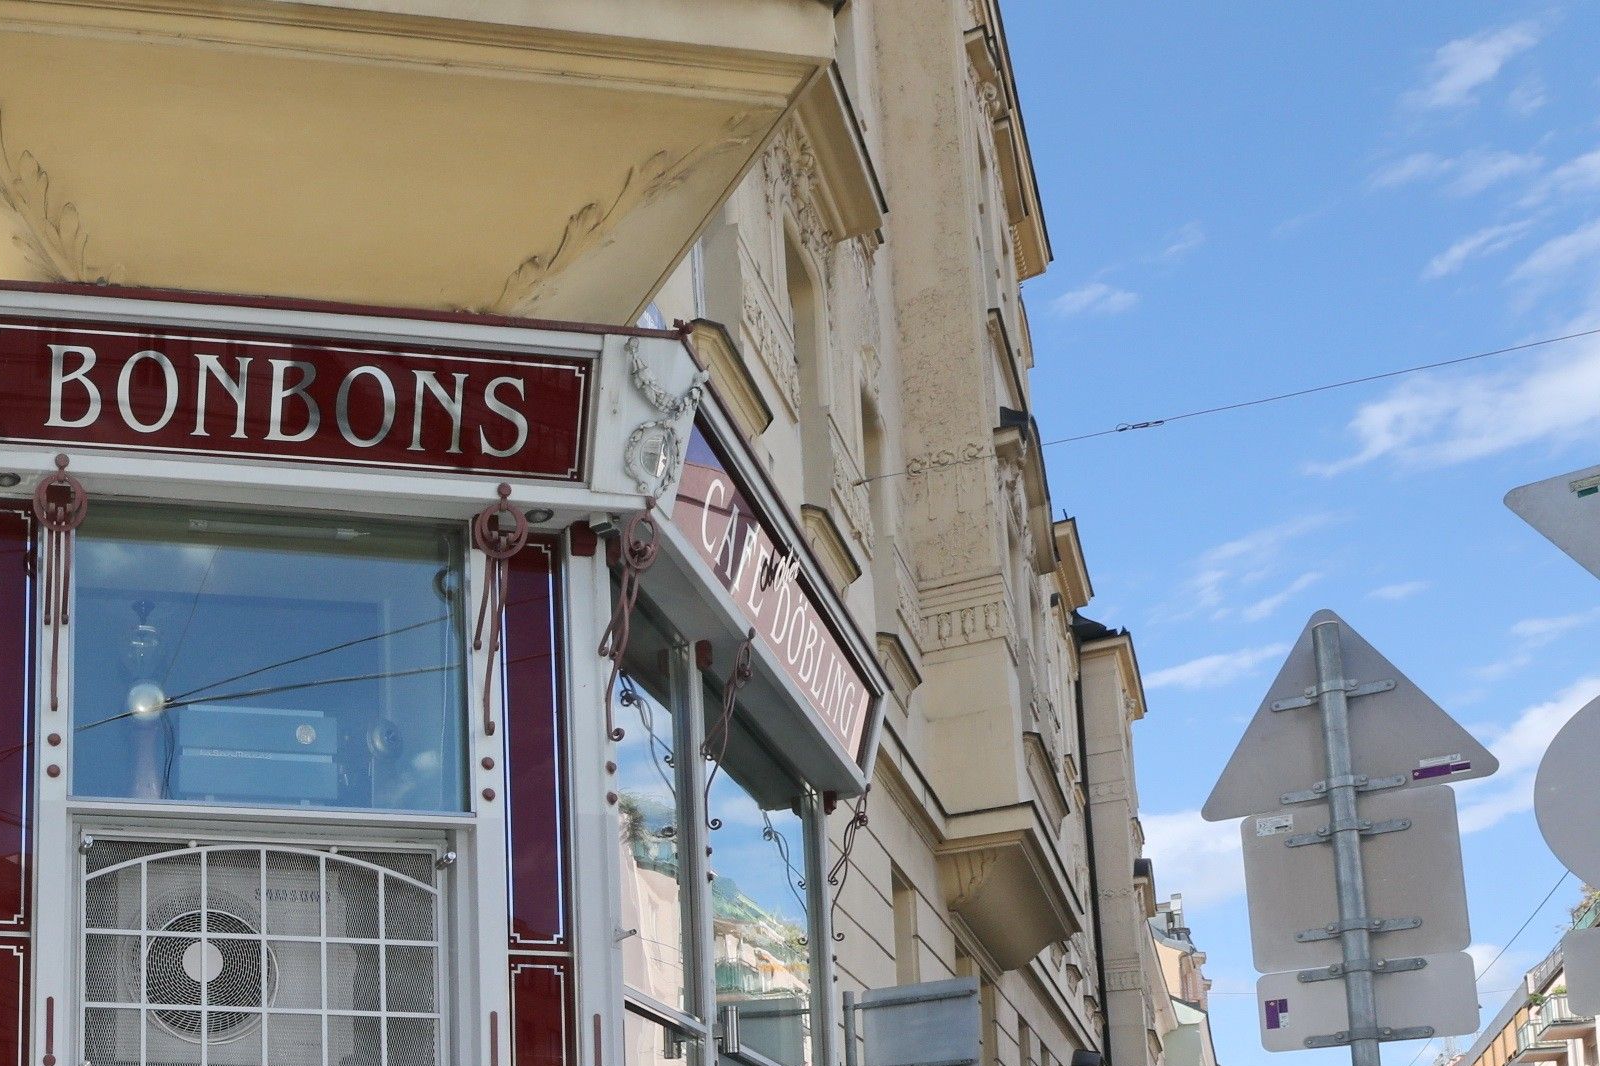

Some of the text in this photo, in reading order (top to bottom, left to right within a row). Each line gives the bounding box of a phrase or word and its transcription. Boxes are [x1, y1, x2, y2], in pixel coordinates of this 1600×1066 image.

[42, 343, 529, 459] BONBONS
[701, 478, 770, 618] CAFE
[769, 582, 857, 738] DÖBLING
